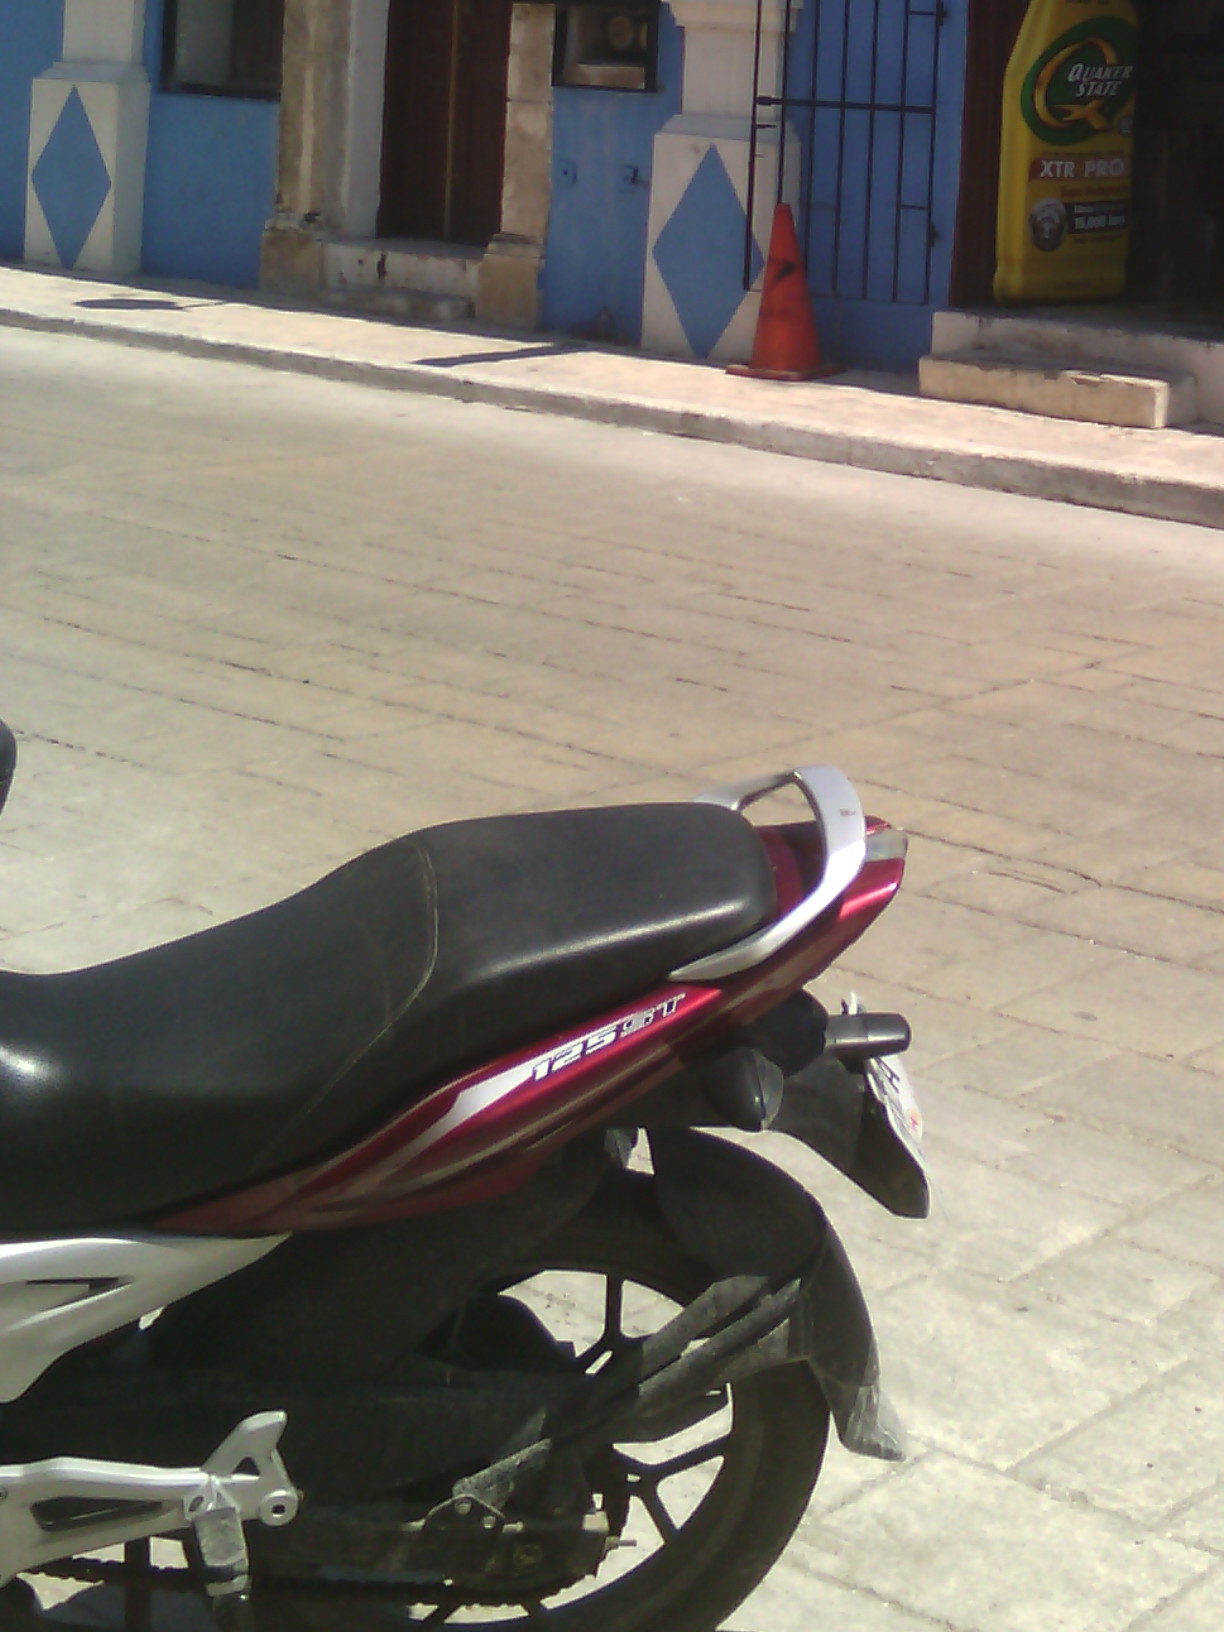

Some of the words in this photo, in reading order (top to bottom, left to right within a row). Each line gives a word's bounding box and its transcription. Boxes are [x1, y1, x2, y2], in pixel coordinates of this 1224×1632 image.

[1075, 80, 1122, 97] STATE
[1040, 159, 1076, 179] XTR
[1084, 158, 1125, 178] PRO
